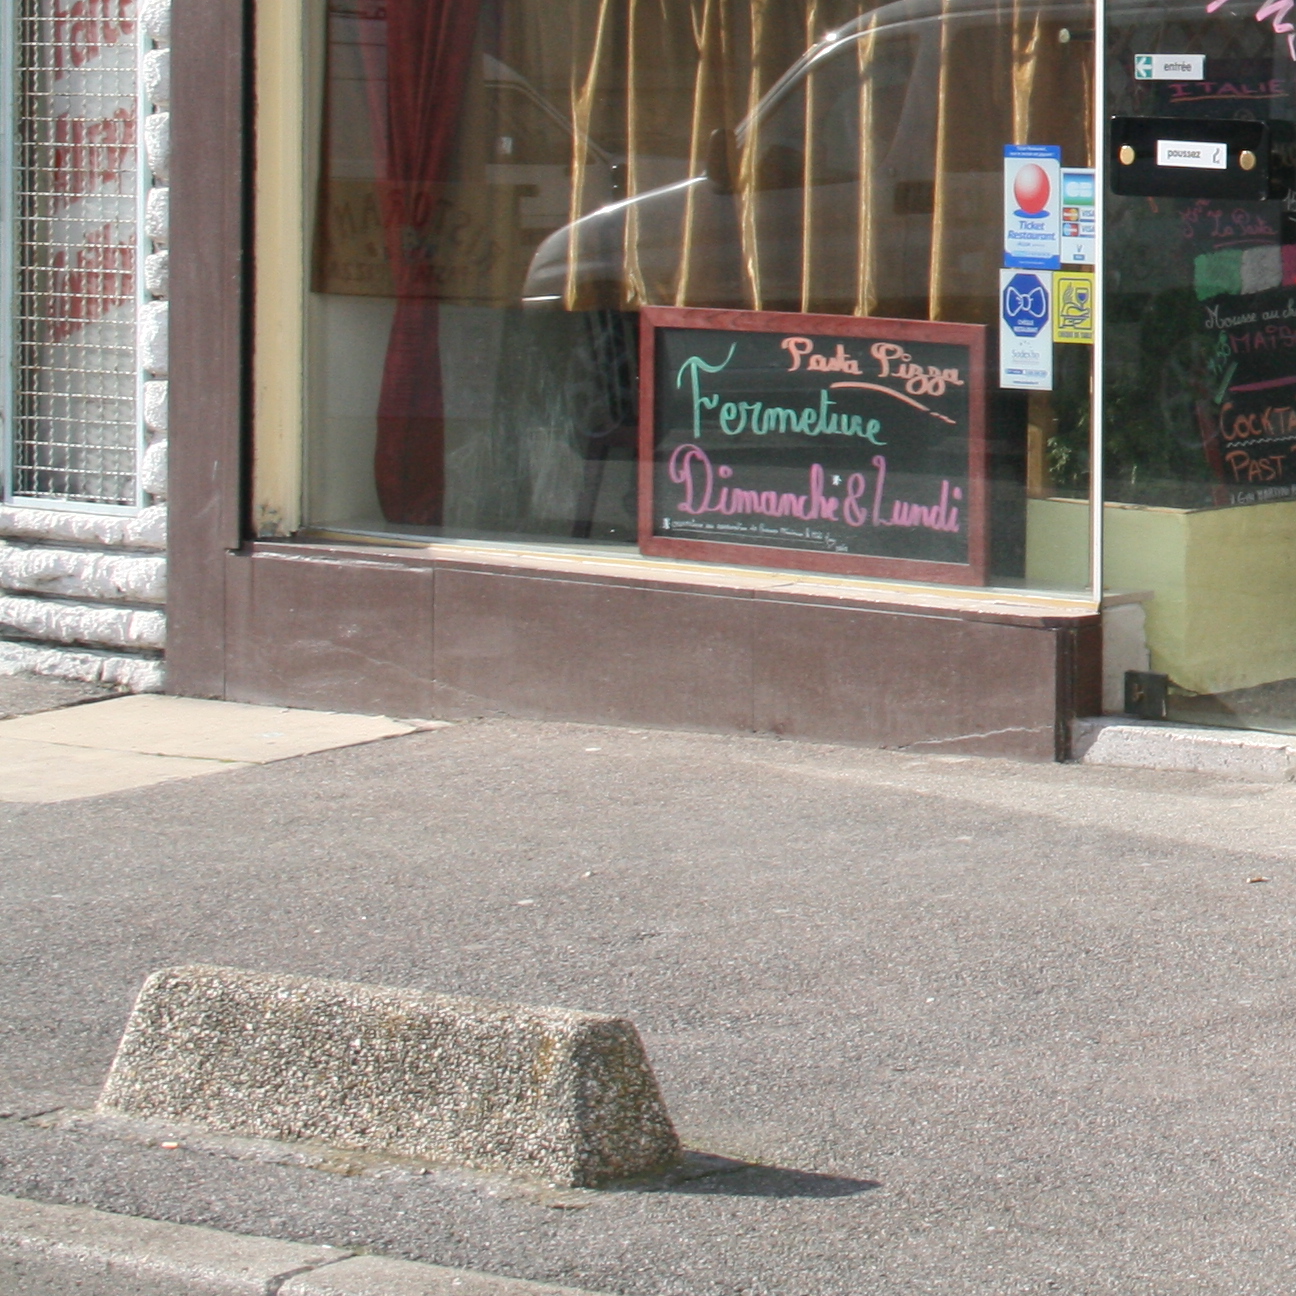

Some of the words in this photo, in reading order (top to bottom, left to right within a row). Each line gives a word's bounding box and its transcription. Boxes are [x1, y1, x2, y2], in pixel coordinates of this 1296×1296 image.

[1163, 60, 1192, 72] entrée
[1167, 148, 1201, 159] poussez
[870, 341, 964, 397] Pizza
[870, 454, 963, 533] Lundi
